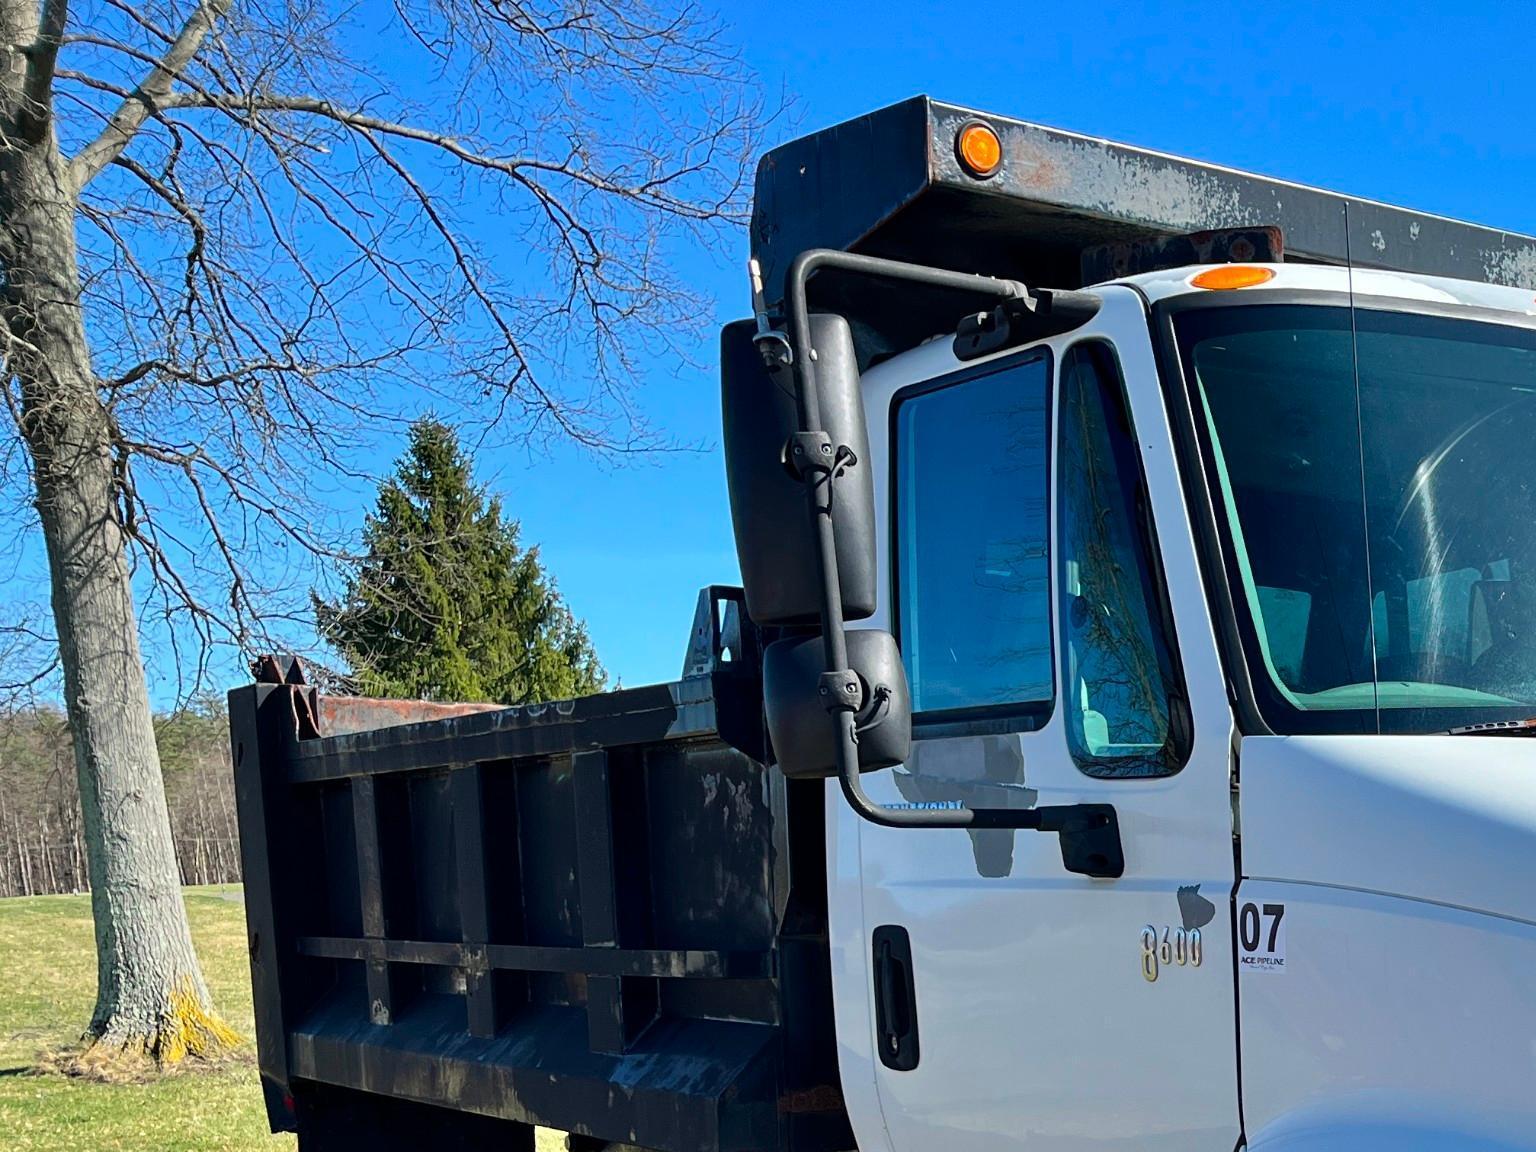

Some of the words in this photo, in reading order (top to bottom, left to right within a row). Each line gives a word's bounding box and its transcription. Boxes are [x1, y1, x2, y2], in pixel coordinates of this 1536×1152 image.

[1140, 924, 1203, 982] 8600
[1240, 902, 1285, 953] 07
[1241, 956, 1257, 965] ACE
